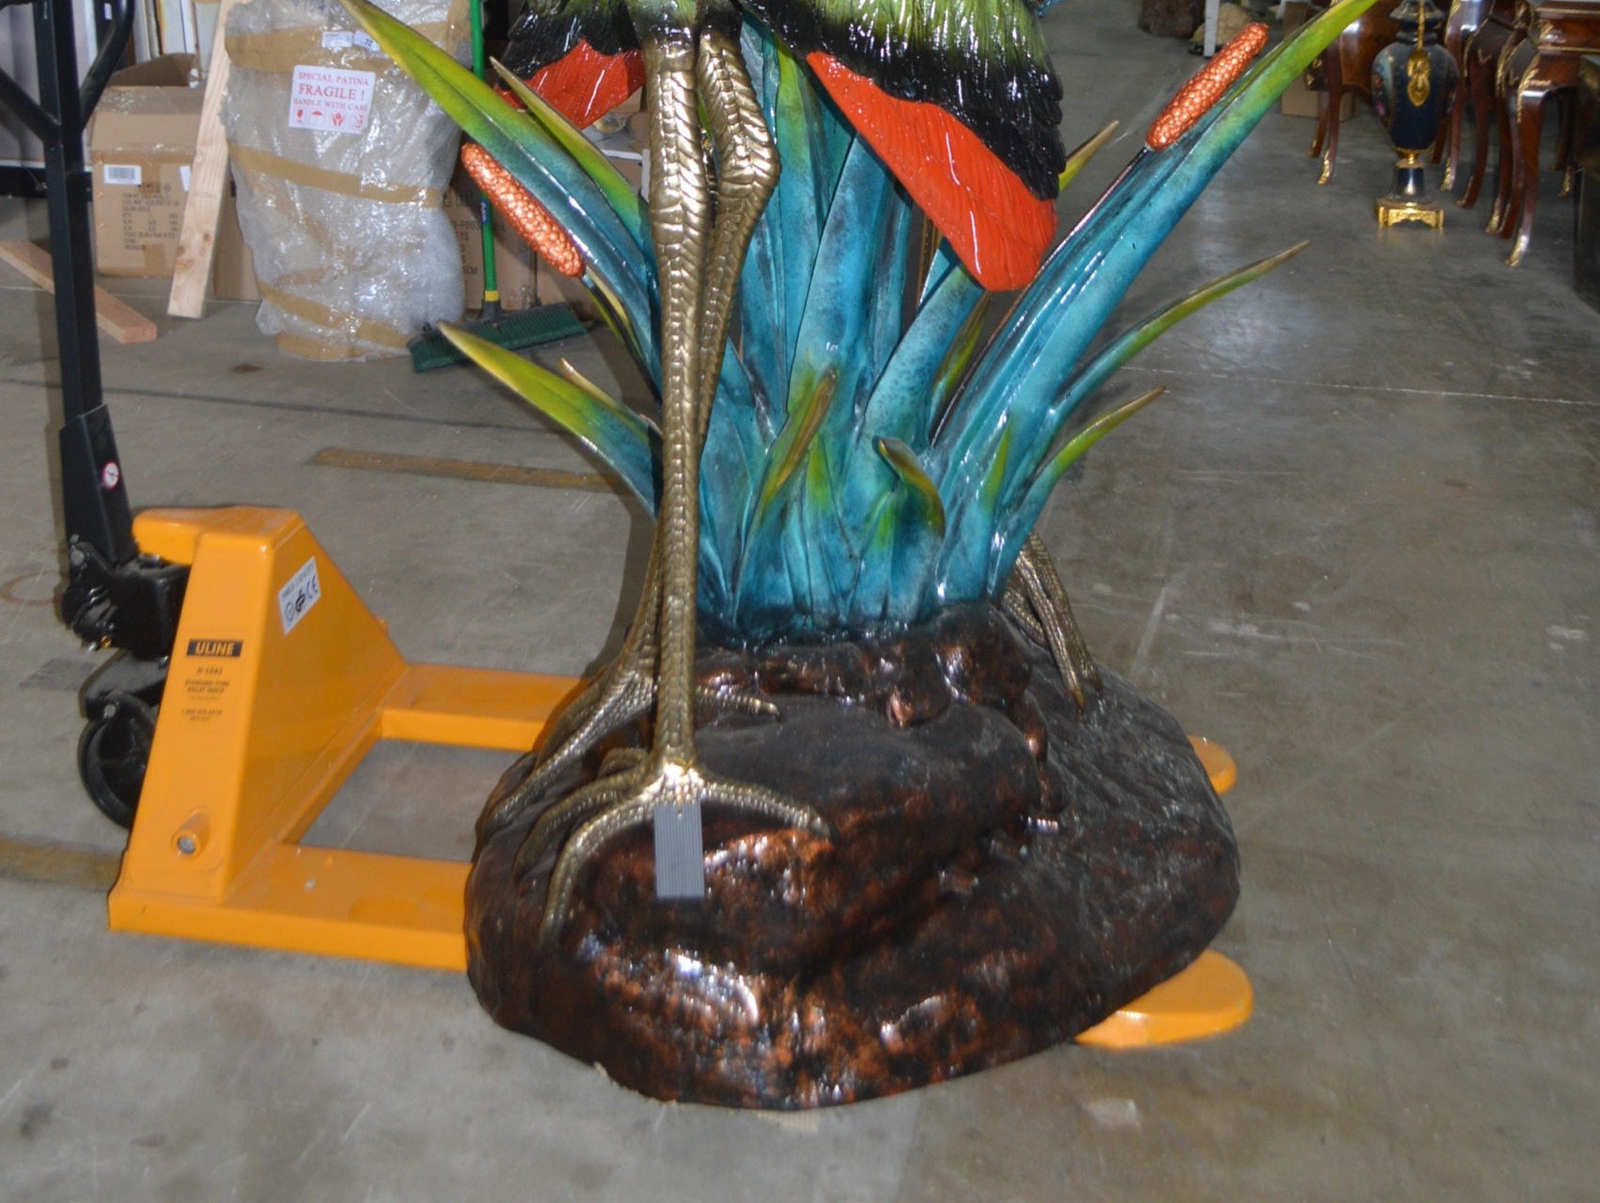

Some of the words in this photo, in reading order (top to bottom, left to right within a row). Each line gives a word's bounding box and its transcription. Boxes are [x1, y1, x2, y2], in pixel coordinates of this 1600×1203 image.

[298, 72, 332, 82] SPECIAL
[336, 76, 369, 86] PATINA
[298, 83, 357, 100] FRAGILE
[325, 101, 346, 109] WITH
[194, 641, 236, 656] ULINE
